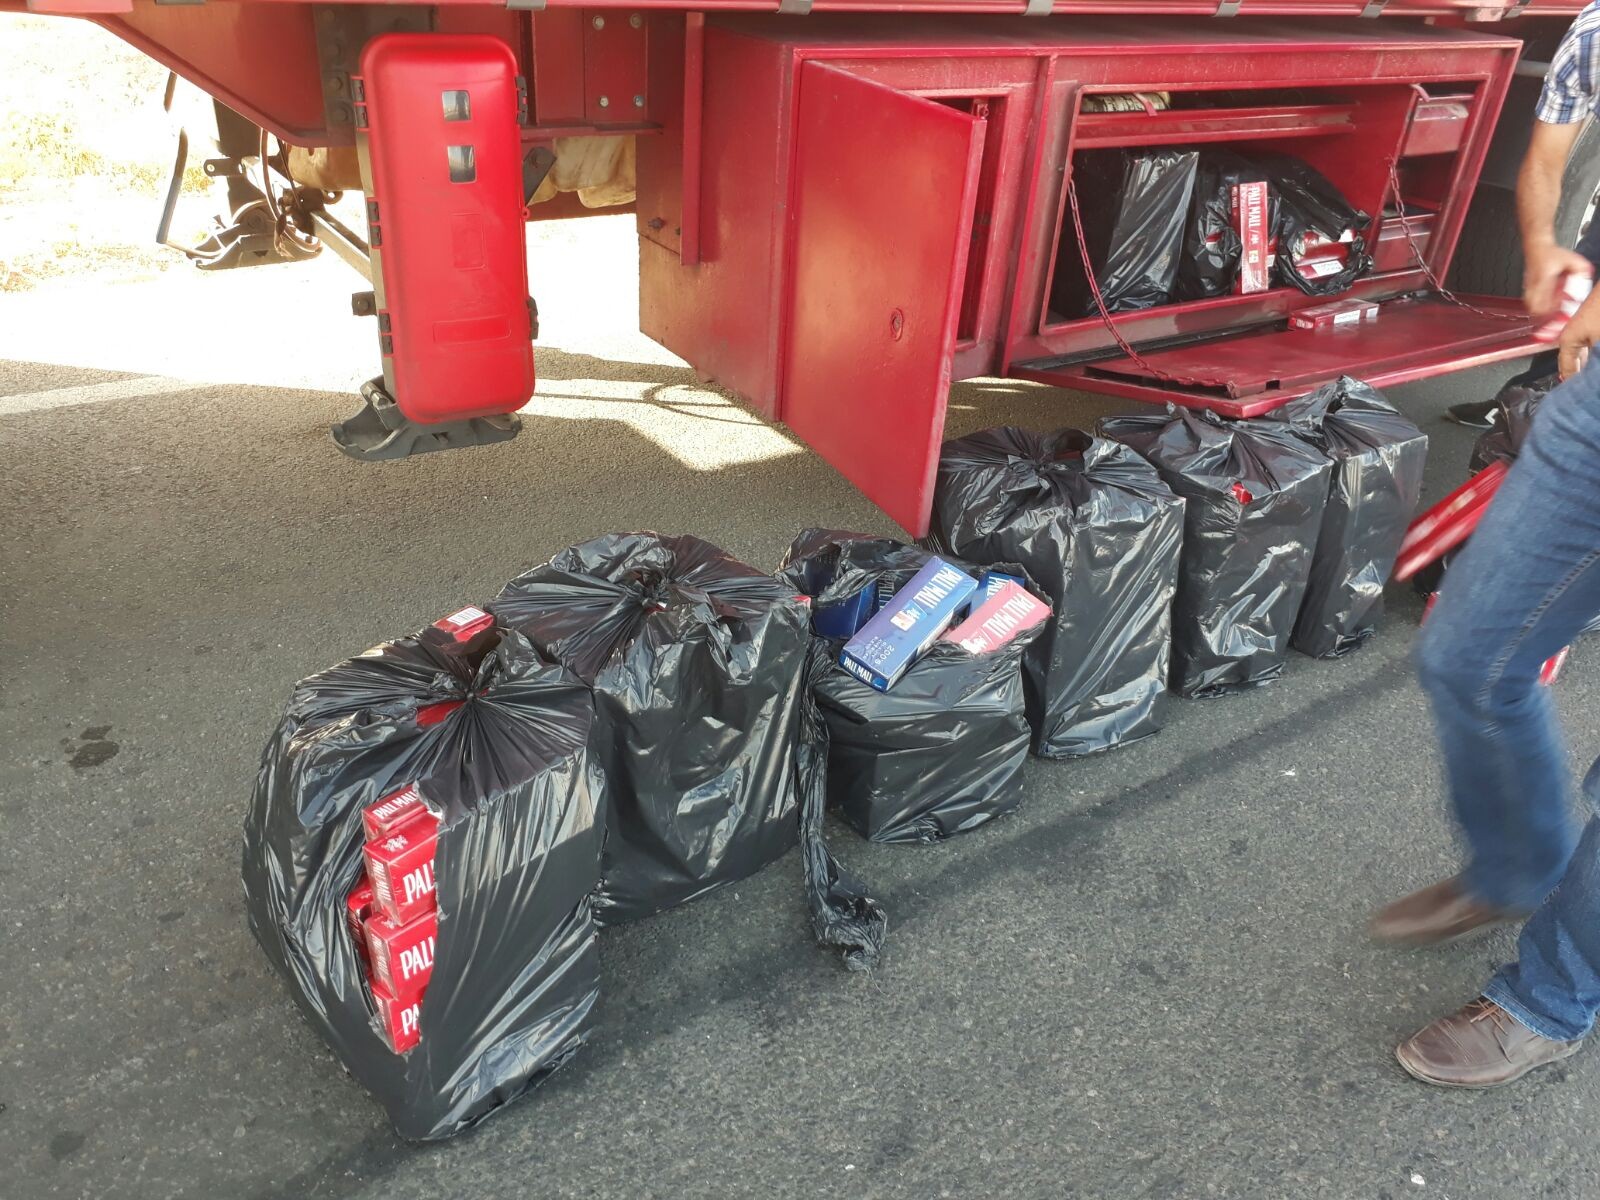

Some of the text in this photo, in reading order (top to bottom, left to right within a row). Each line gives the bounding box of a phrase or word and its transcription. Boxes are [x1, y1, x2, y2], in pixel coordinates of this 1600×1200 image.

[1248, 187, 1261, 227] PALL MALL
[913, 566, 963, 609] PALL MALL
[982, 592, 1036, 639] PALL MALL
[843, 656, 873, 683] PALL MALL
[372, 801, 399, 819] PALL
